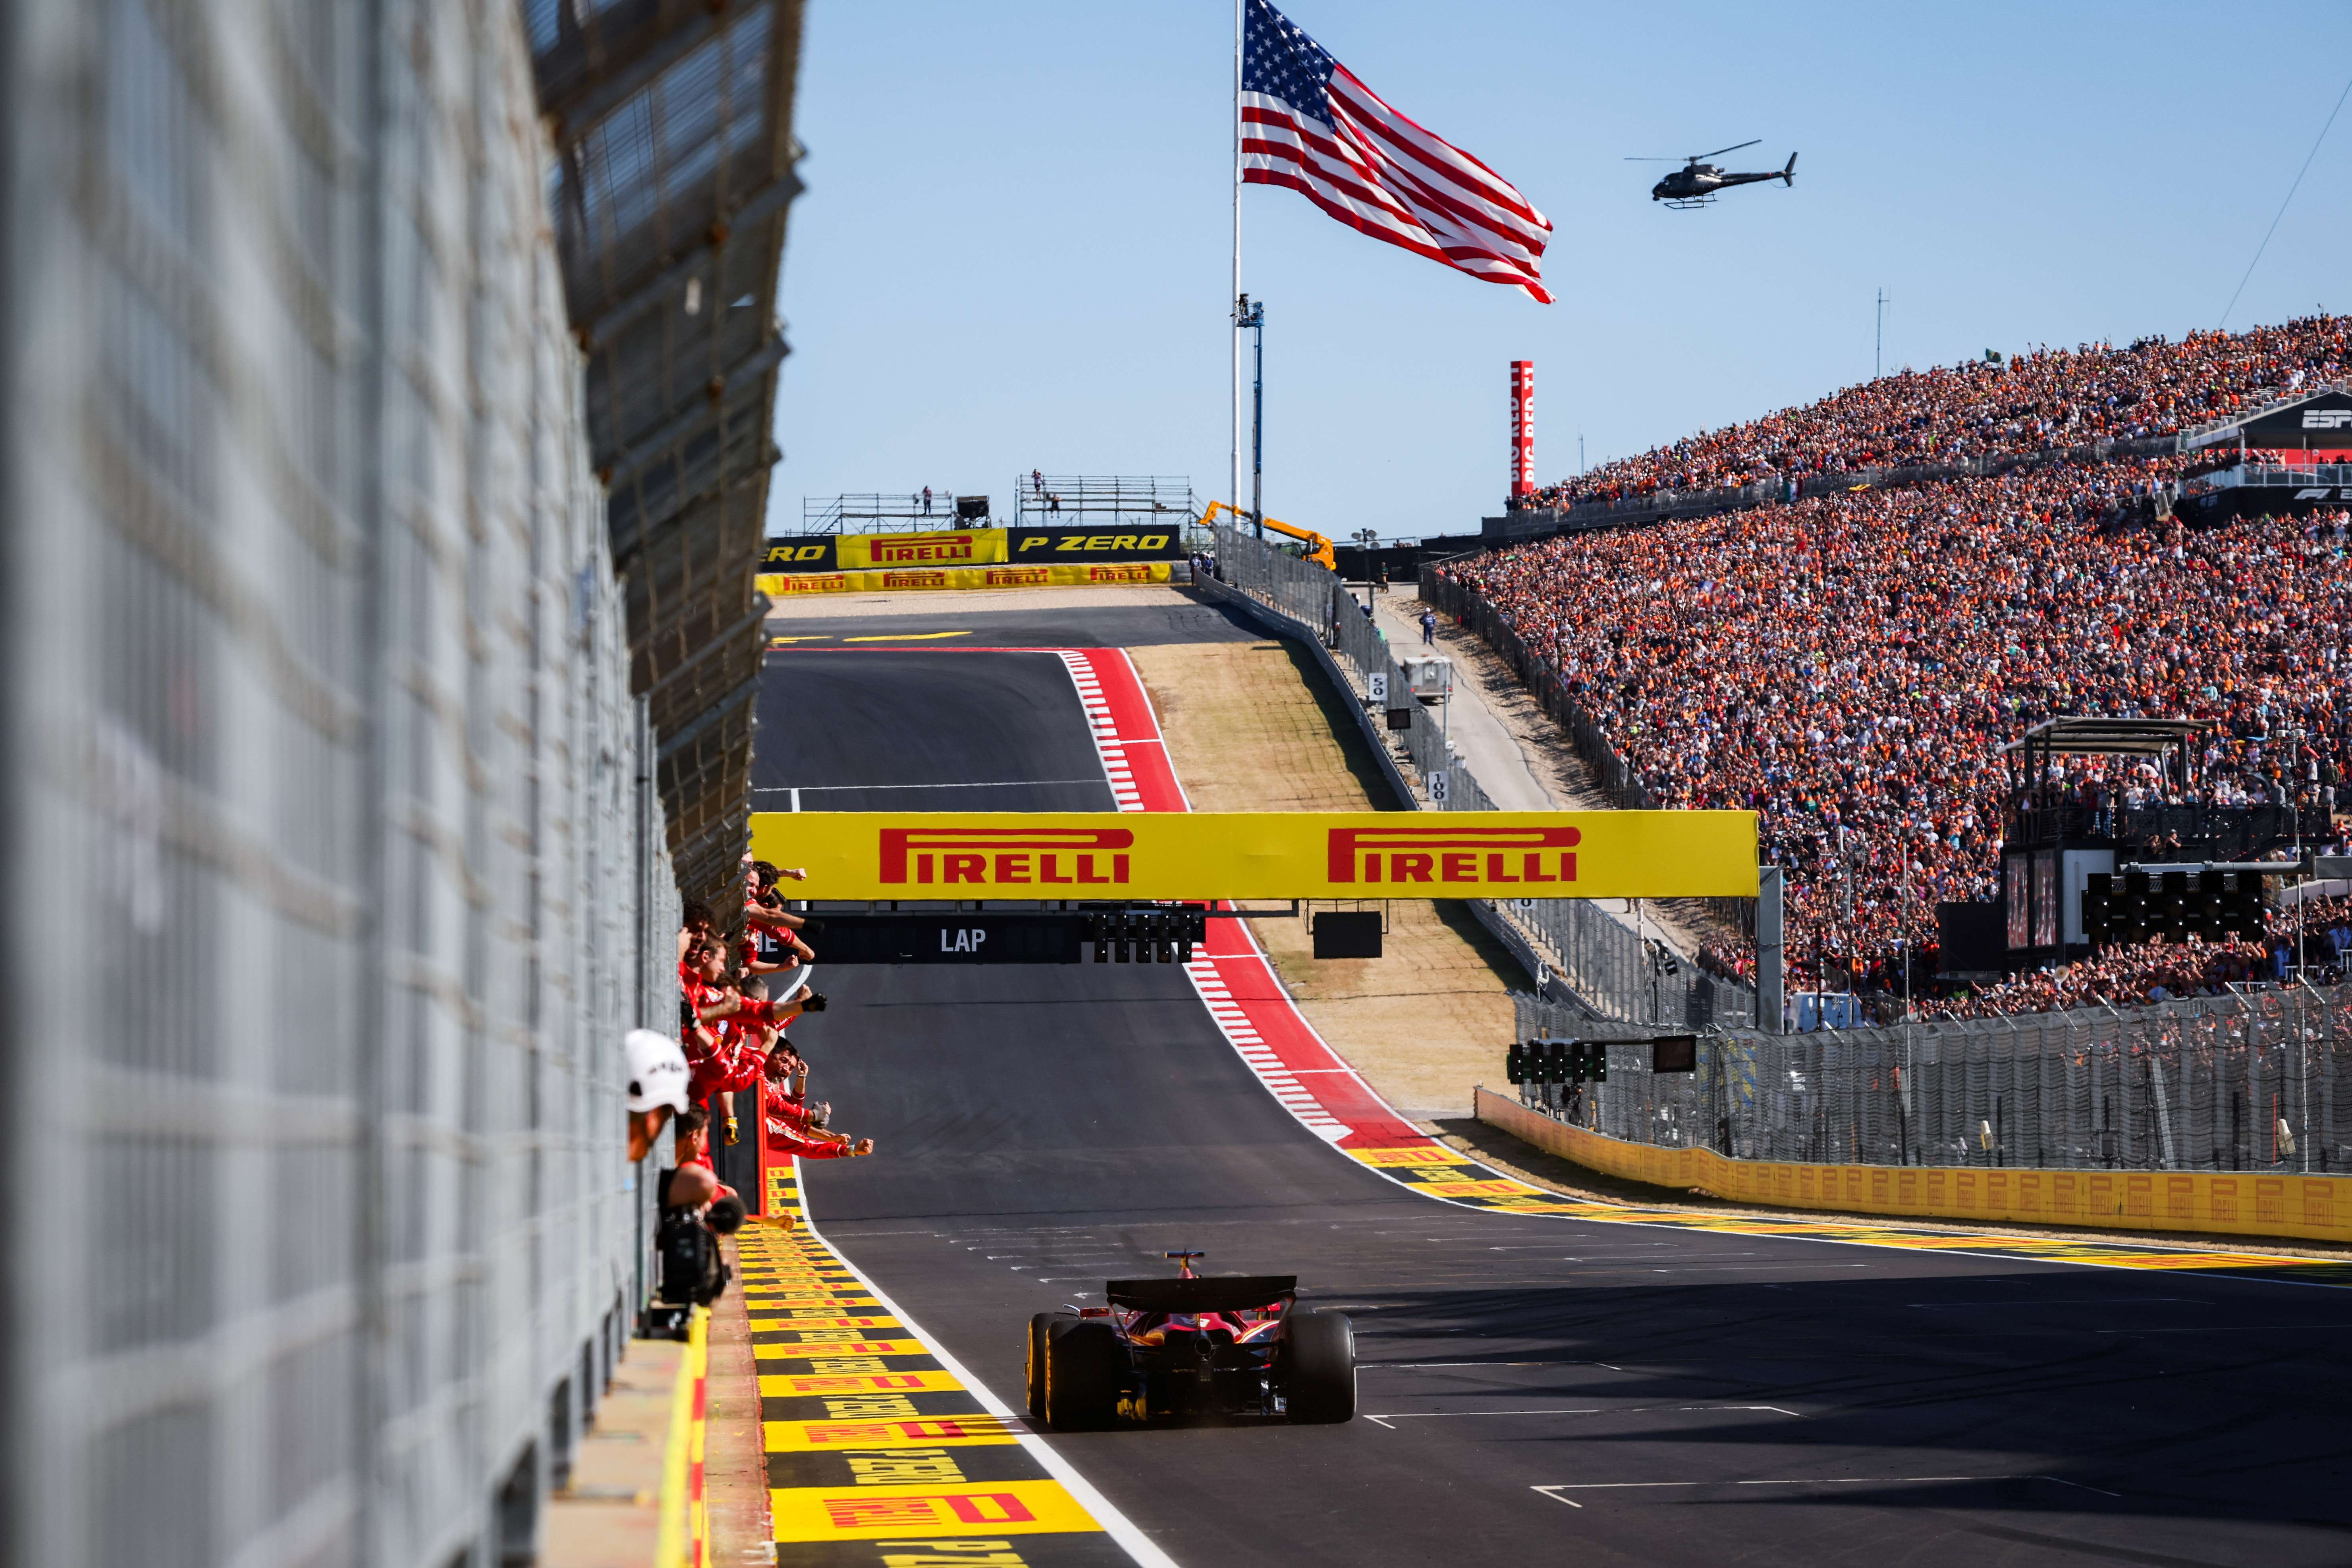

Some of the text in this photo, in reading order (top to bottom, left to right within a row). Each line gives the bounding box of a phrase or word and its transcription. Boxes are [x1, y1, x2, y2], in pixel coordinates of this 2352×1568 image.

[2302, 409, 2352, 428] ESP
[870, 536, 972, 561] PIRELLI
[1018, 535, 1169, 552] P ZERO
[783, 575, 845, 590] PIRELLI
[884, 572, 945, 587] PIRELLI
[986, 569, 1048, 584] PIRELLI
[1090, 565, 1150, 581] PIRELLI
[1434, 773, 1444, 800] 100
[880, 828, 1134, 883] PIRELLI
[1328, 827, 1581, 883] PIRELLI
[941, 929, 986, 952] LAP
